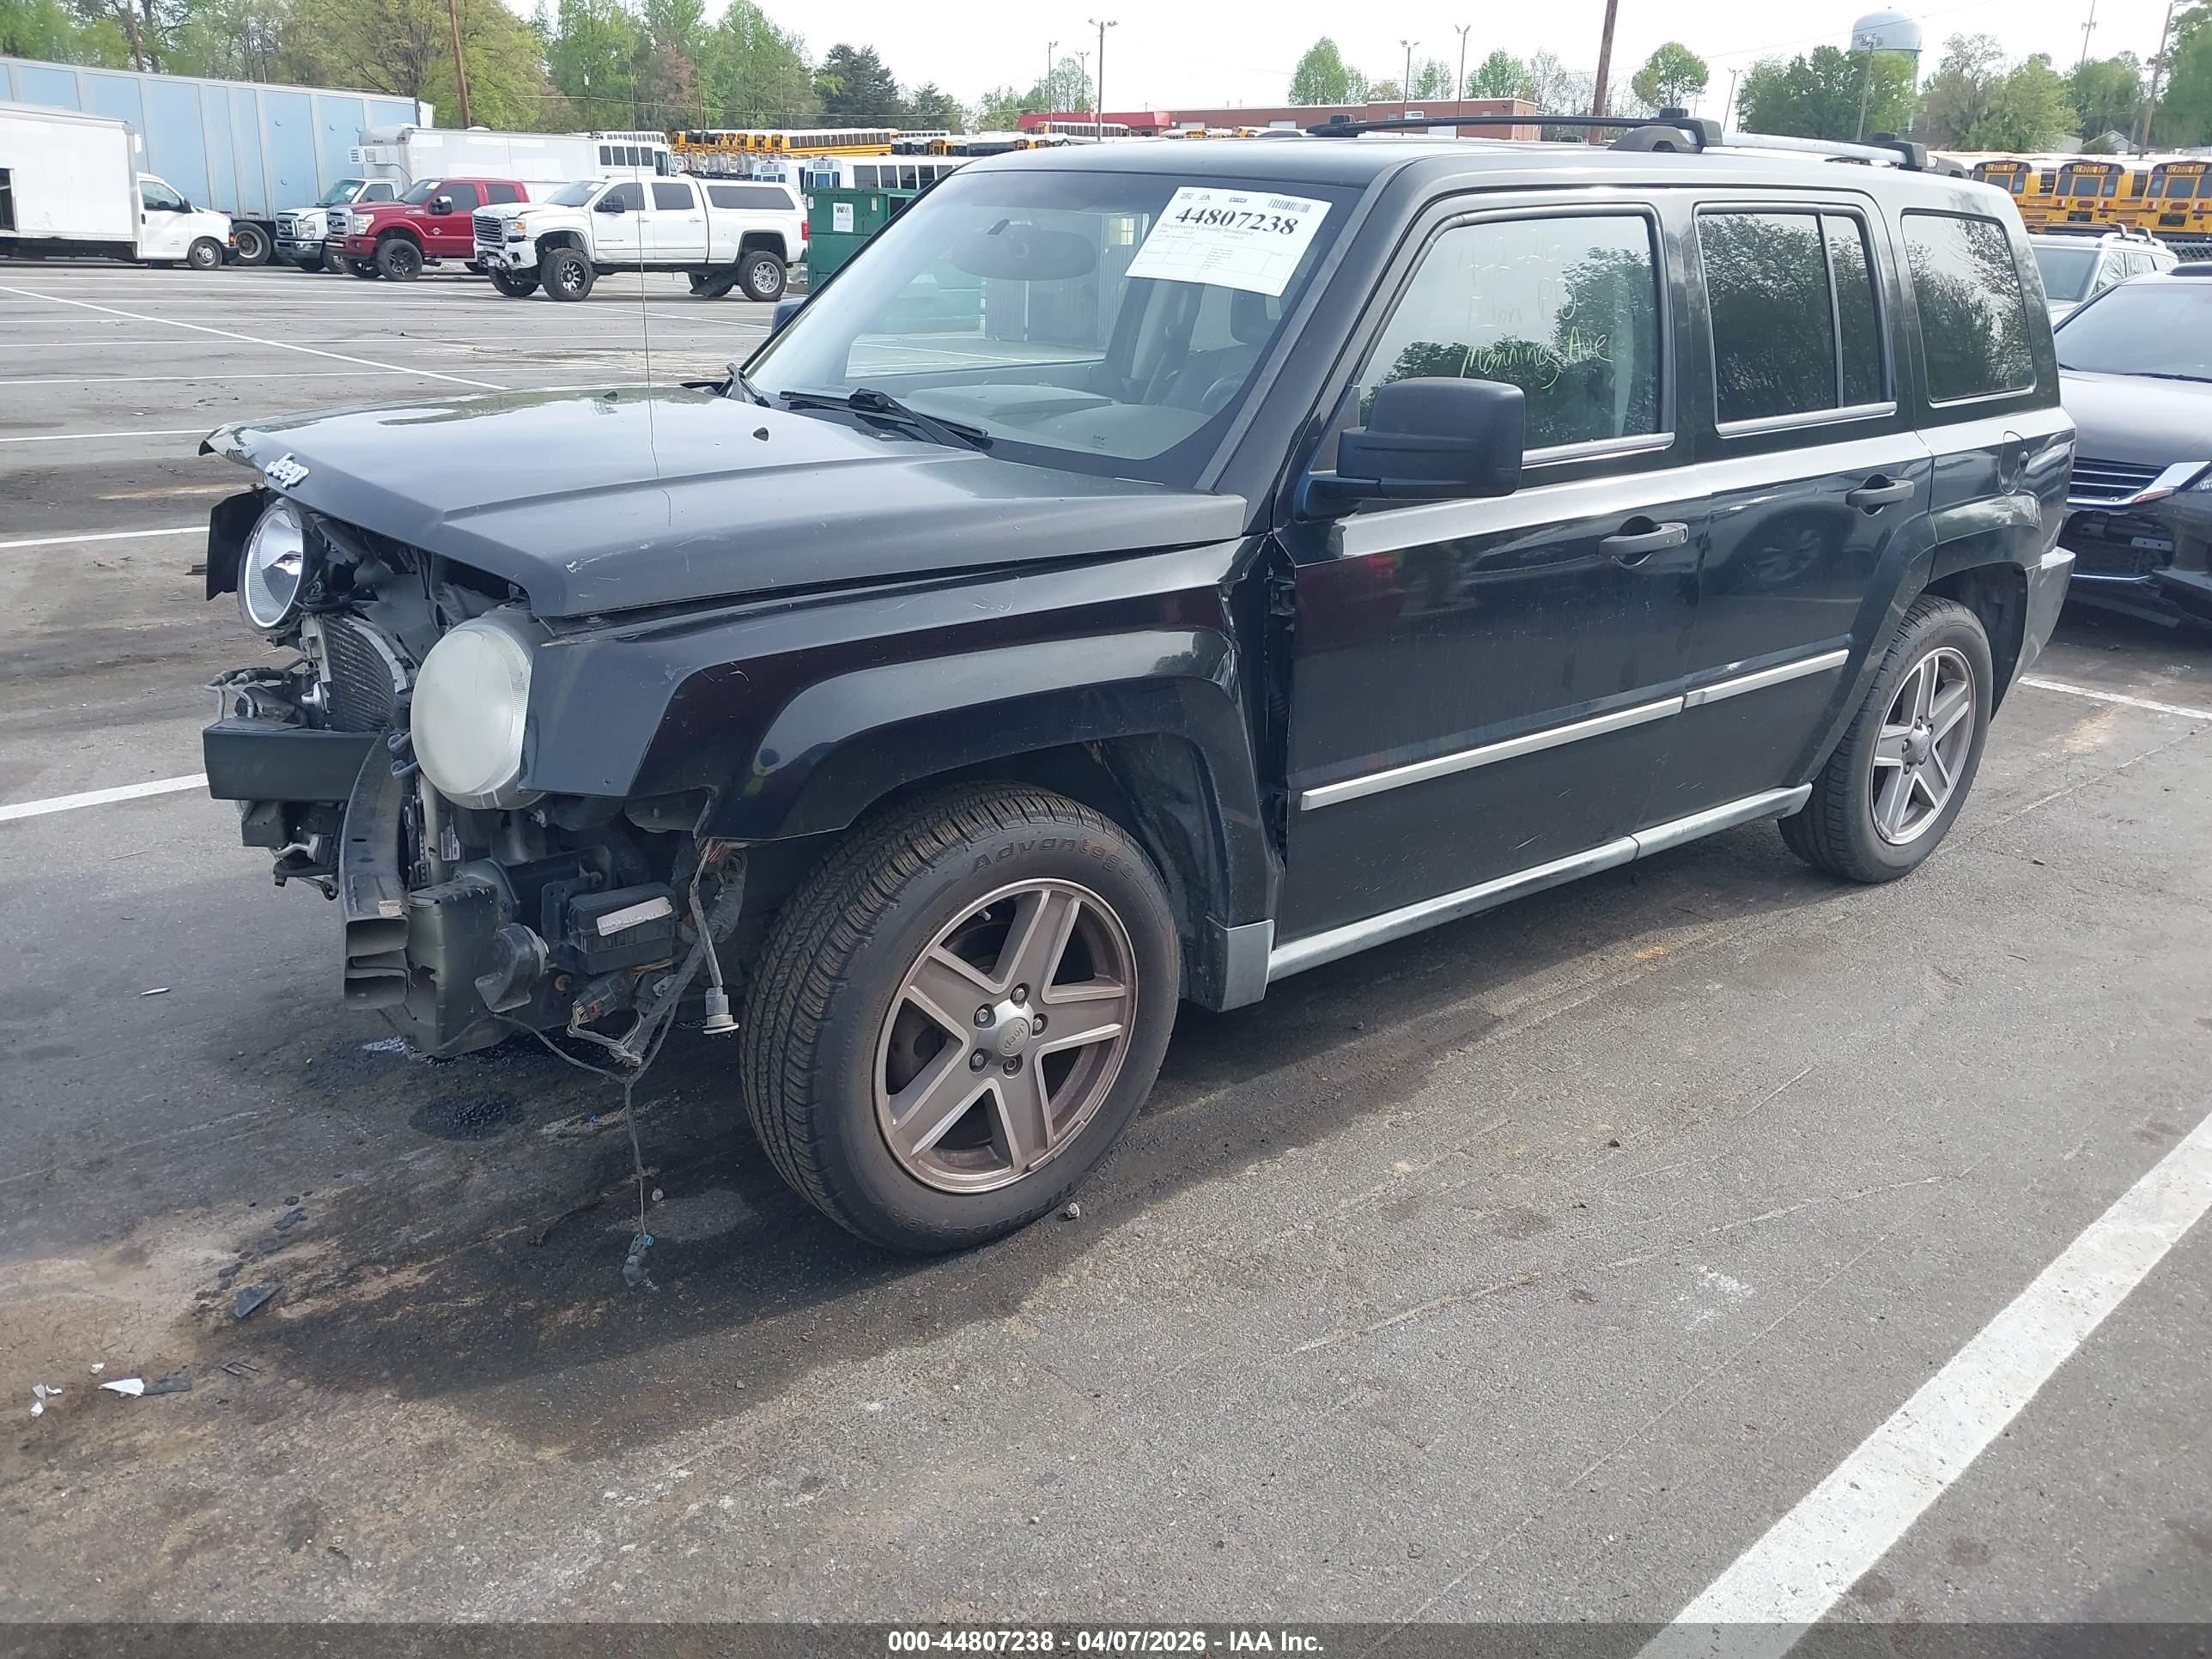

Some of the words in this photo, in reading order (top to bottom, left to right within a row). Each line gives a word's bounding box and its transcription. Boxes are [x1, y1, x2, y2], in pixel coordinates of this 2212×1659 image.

[1176, 207, 1298, 235] 44807238
[1568, 326, 1614, 364] Ave
[265, 452, 310, 489] Jeep
[974, 836, 1134, 880] Advantage
[1002, 1023, 1024, 1050] Jeep
